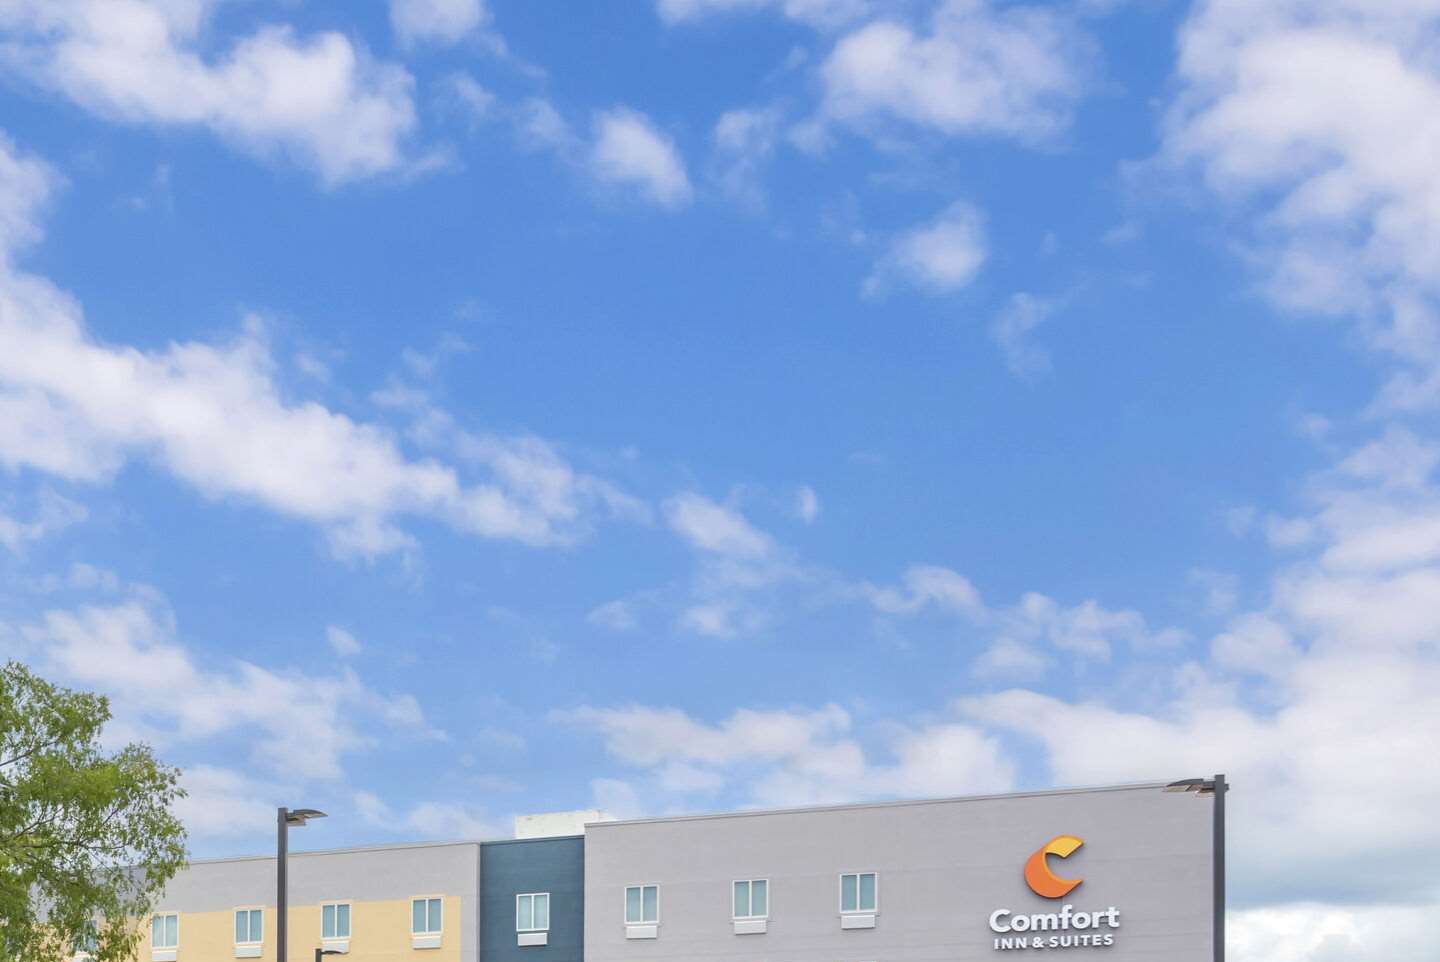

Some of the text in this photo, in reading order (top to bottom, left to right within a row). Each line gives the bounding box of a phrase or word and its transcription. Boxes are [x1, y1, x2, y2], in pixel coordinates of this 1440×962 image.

[989, 904, 1120, 933] Comfort
[994, 934, 1113, 950] INN & SUITES
